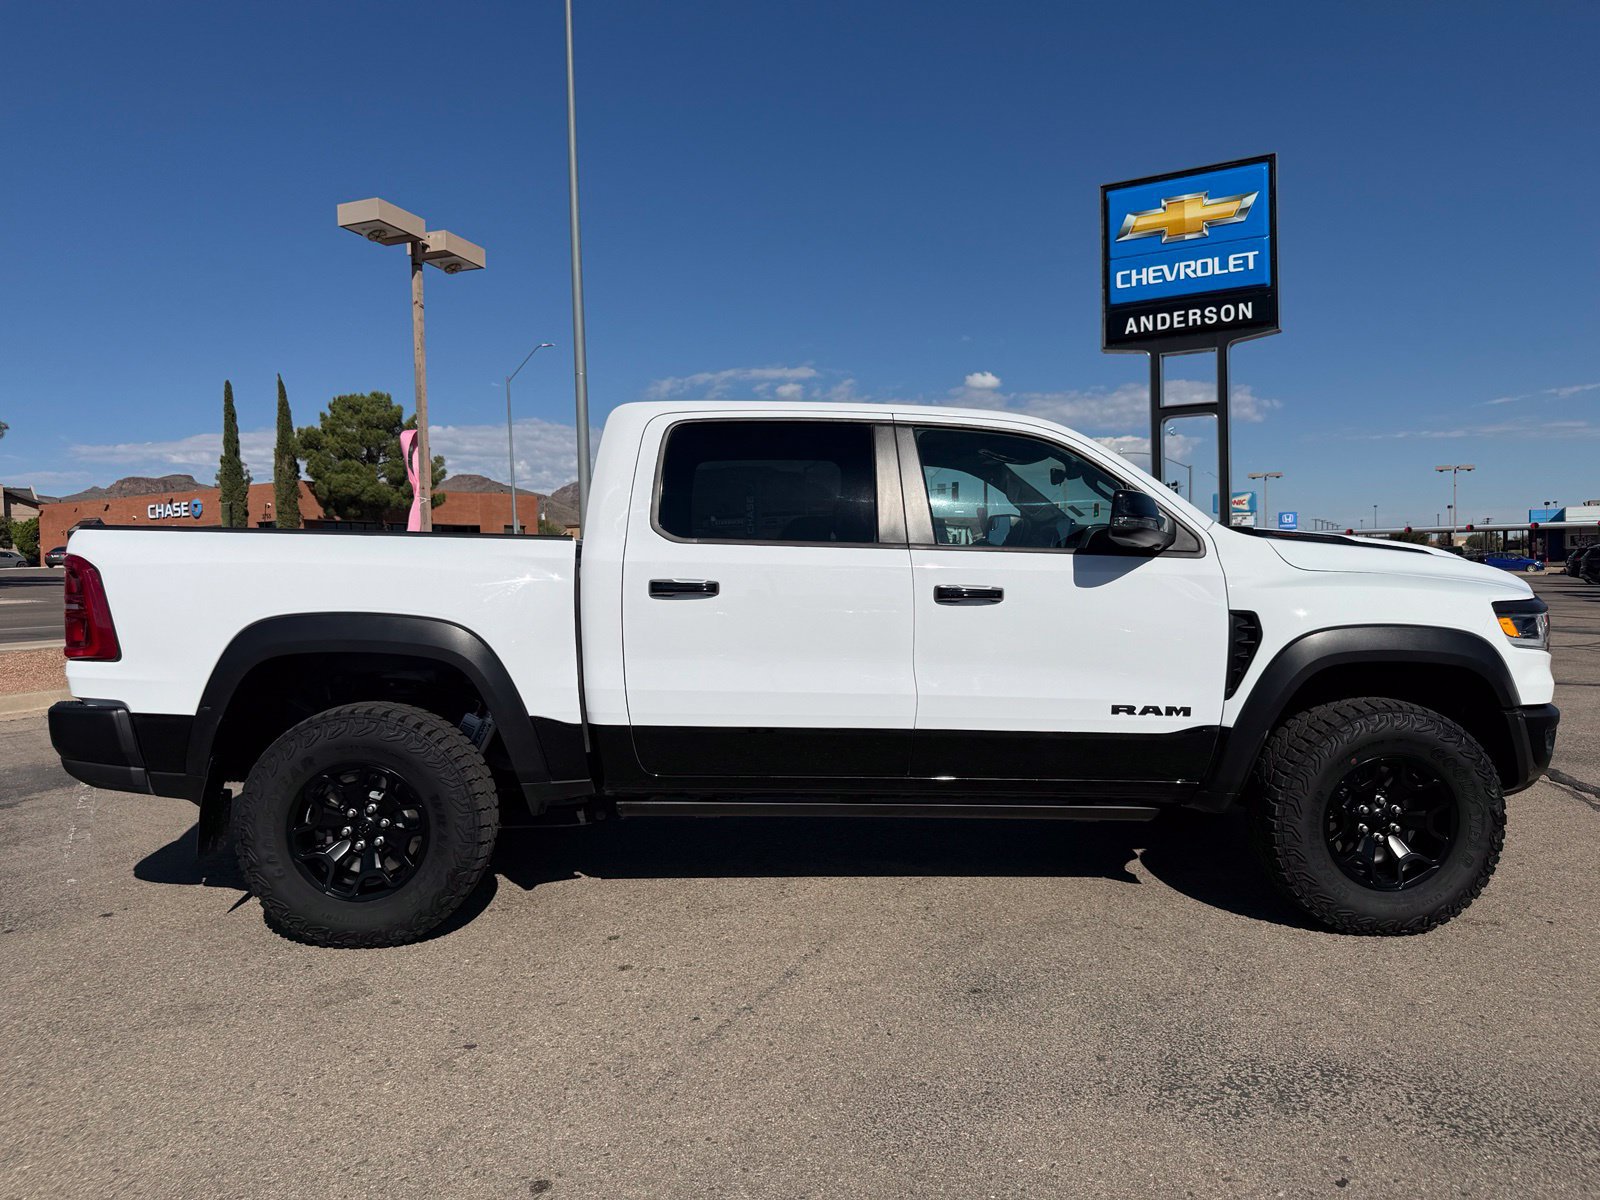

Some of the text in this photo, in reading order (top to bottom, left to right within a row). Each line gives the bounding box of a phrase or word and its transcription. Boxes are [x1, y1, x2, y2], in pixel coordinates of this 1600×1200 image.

[1115, 250, 1259, 289] CHEVROLET
[1124, 301, 1253, 335] ANDERSON
[147, 501, 190, 519] CHASE
[1111, 704, 1192, 717] RAM
